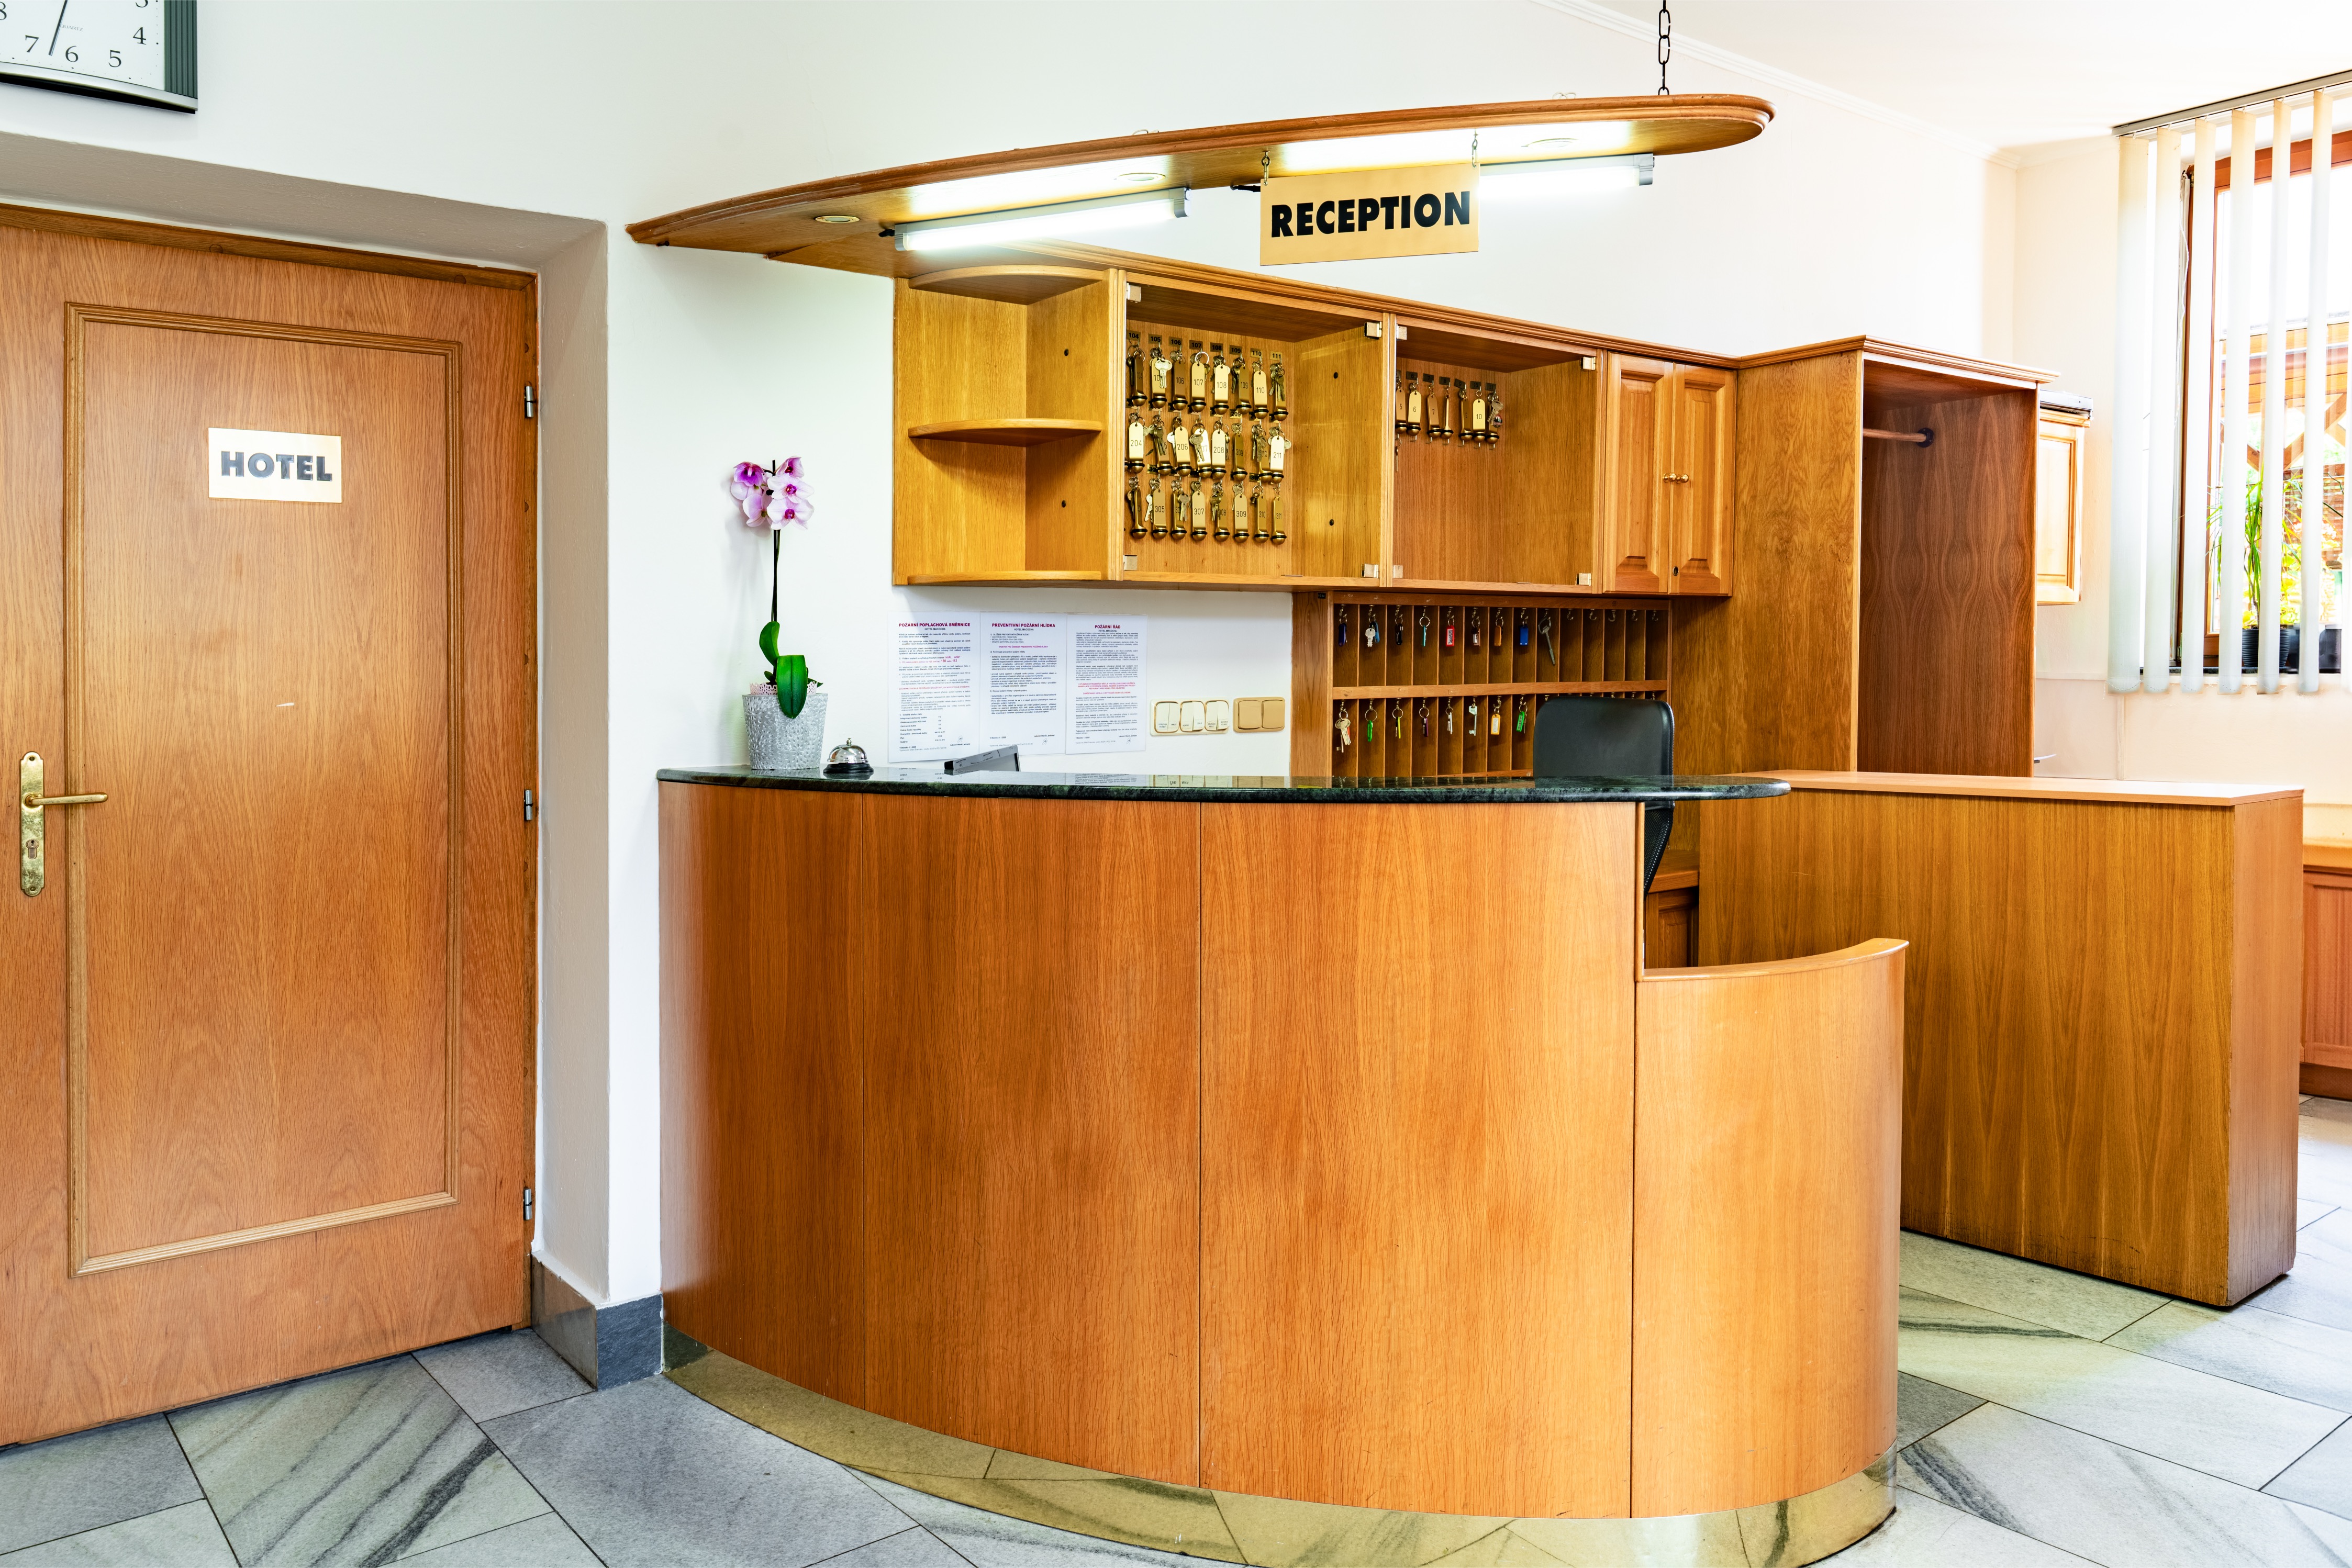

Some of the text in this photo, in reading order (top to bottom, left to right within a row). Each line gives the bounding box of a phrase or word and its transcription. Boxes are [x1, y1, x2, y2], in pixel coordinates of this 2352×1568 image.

[25, 35, 39, 53] 7
[132, 27, 147, 45] 4
[65, 46, 79, 62] 6
[108, 49, 122, 68] 5
[1271, 191, 1470, 238] RECEPTION
[221, 451, 332, 481] HOTEL
